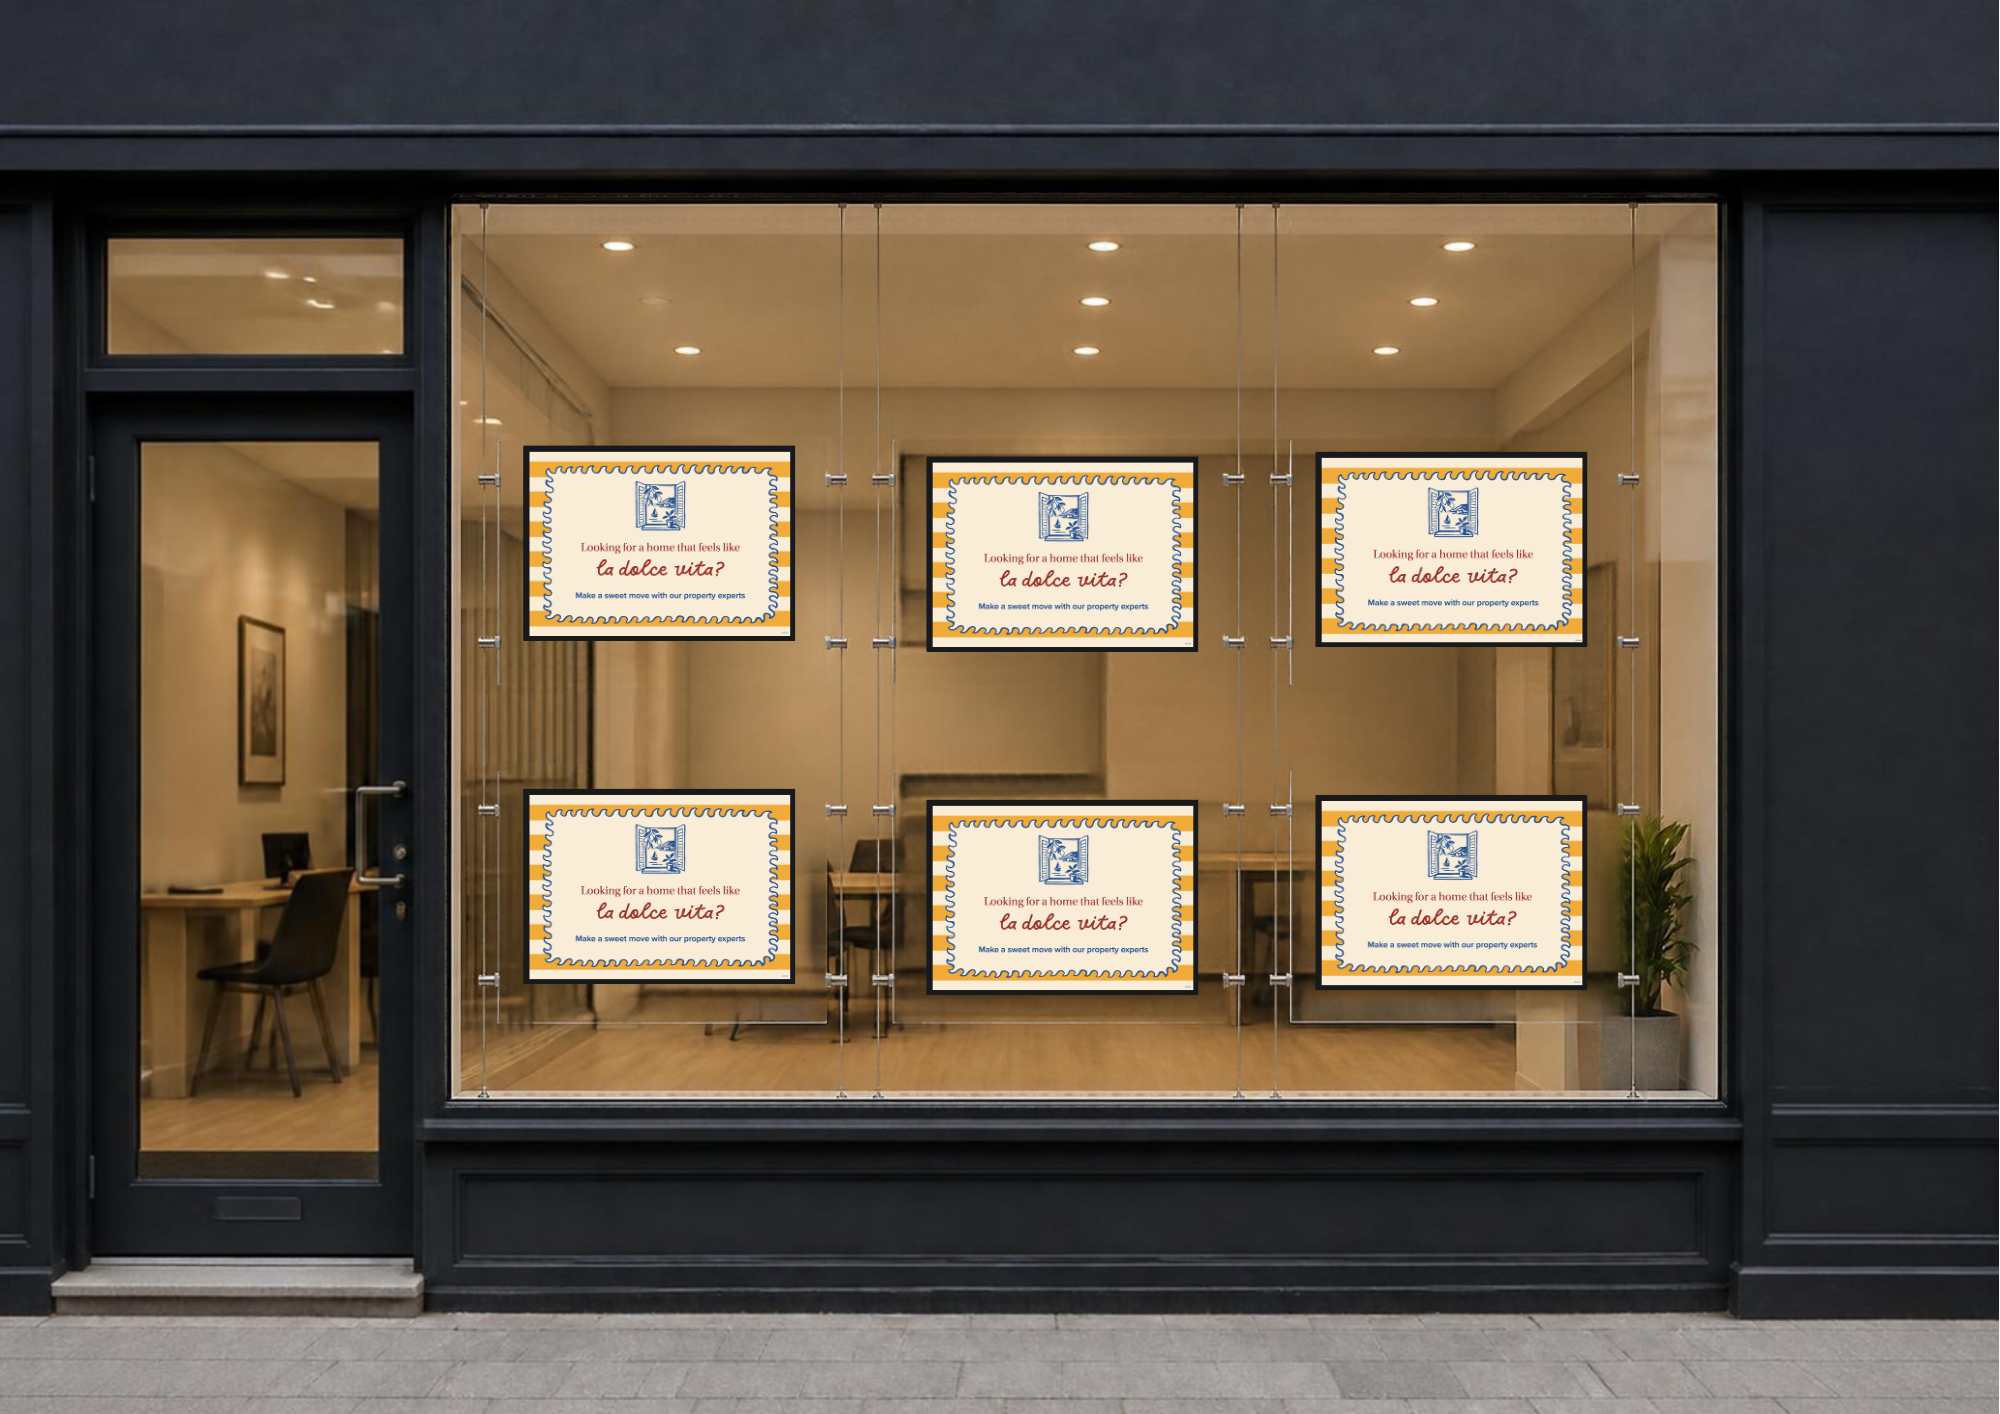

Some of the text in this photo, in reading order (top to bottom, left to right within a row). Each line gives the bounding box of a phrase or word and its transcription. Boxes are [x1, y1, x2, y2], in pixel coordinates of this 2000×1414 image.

[581, 542, 621, 554] Looking
[623, 542, 637, 552] for
[647, 543, 675, 552] home
[677, 543, 696, 552] that
[699, 542, 720, 552] feels
[723, 542, 740, 552] like
[1373, 549, 1414, 561] Looking
[1415, 549, 1429, 559] for
[1439, 549, 1468, 559] home
[1469, 549, 1489, 559] that
[1491, 549, 1514, 559] feels
[1515, 549, 1533, 559] like
[984, 553, 1024, 565] Looking
[1026, 553, 1040, 563] for
[1050, 553, 1078, 563] home
[1080, 553, 1099, 563] that
[1102, 553, 1123, 563] feels
[1126, 553, 1143, 563] like
[596, 559, 725, 577] la dolce vita?
[1388, 566, 1518, 584] la dolce vita?
[999, 570, 1128, 588] la dolce vita?
[581, 886, 621, 897] Looking
[623, 885, 637, 895] for
[647, 886, 675, 895] home
[677, 886, 696, 895] that
[699, 886, 720, 895] feels
[723, 886, 740, 895] like
[1373, 892, 1414, 903] Looking
[1415, 892, 1429, 901] for
[1439, 892, 1468, 901] home
[1469, 892, 1489, 901] that
[1491, 892, 1514, 901] feels
[1515, 892, 1533, 901] like
[984, 897, 1024, 908] Looking
[1026, 896, 1040, 906] for
[1050, 897, 1078, 906] home
[1080, 897, 1099, 906] that
[1102, 896, 1123, 906] feels
[1126, 897, 1143, 906] like
[596, 902, 725, 920] la dolce vita?
[1388, 908, 1518, 926] la dolce vita?
[999, 913, 1128, 931] la dolce vita?
